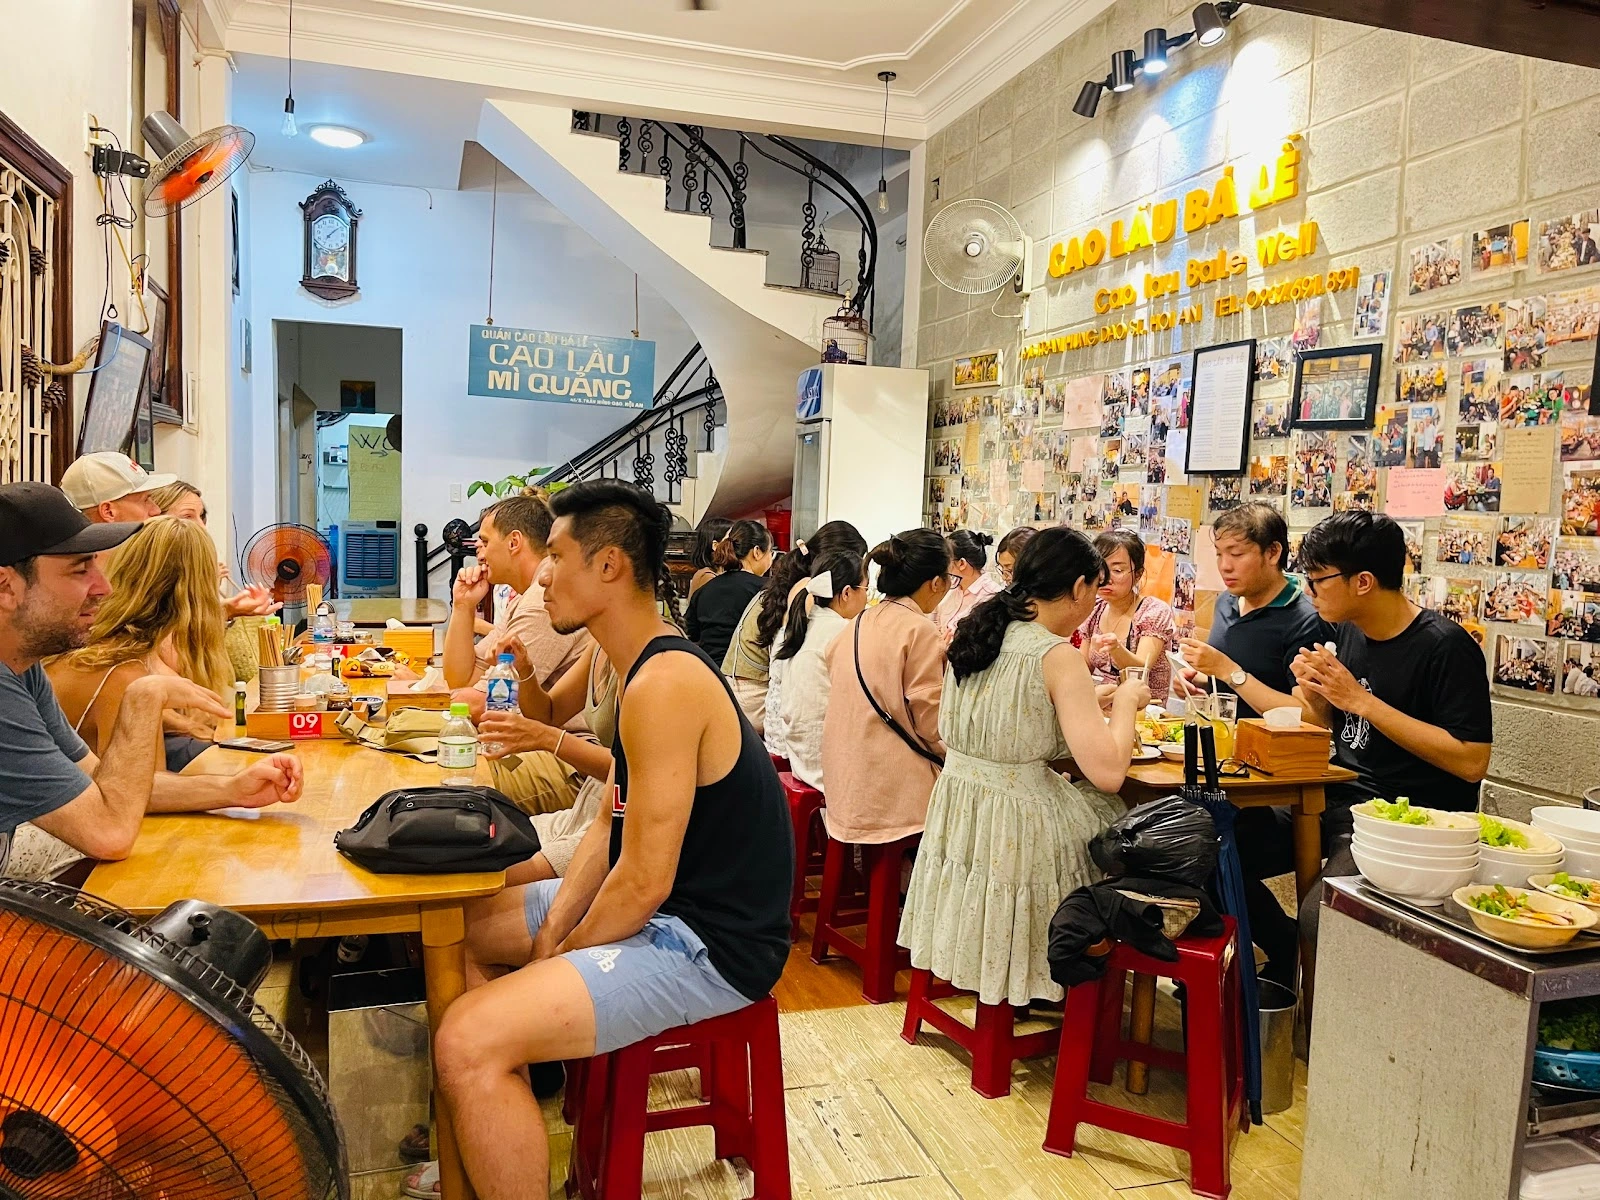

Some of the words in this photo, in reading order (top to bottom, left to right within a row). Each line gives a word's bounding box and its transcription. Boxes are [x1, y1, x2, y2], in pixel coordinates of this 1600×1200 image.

[1048, 228, 1107, 278] CAO
[1184, 166, 1239, 233] BÁ
[1094, 284, 1138, 314] Cao
[1186, 250, 1247, 288] BaLe
[1257, 221, 1317, 267] Well
[481, 328, 512, 341] QUÁN
[514, 332, 536, 344] CAO
[1101, 323, 1128, 343] DAO
[1178, 303, 1203, 325] AN
[489, 343, 554, 369] CAO
[567, 343, 631, 376] LẦU
[488, 367, 520, 391] MÌ
[528, 371, 633, 400] QUẢNG
[293, 713, 319, 729] 09
